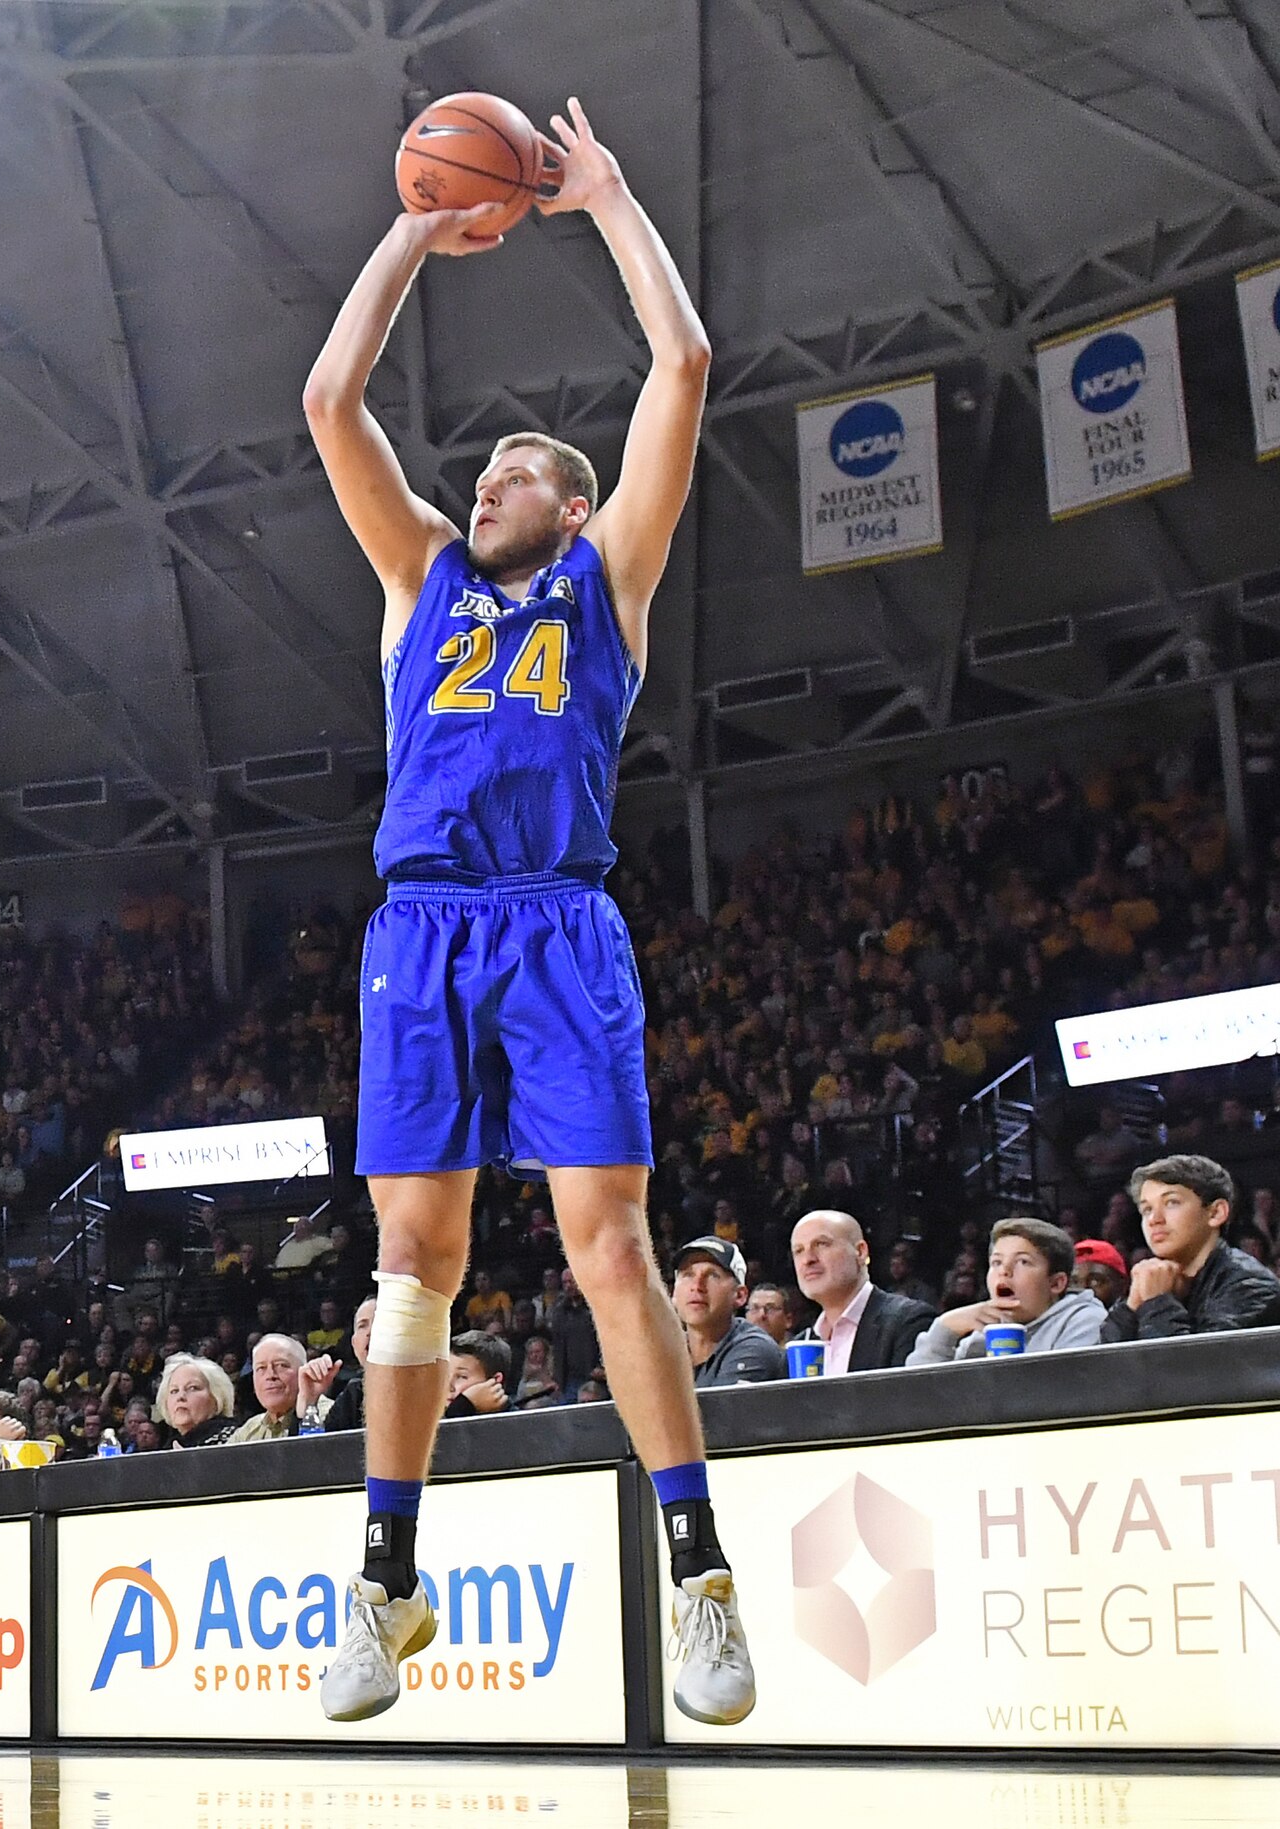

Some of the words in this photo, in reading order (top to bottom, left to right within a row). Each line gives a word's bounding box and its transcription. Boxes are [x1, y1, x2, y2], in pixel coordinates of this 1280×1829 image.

[1083, 411, 1149, 441] FINAL
[1088, 428, 1144, 459] FOUR
[1091, 451, 1145, 485] 1965
[819, 474, 921, 505] MIDWEST
[816, 490, 923, 524] REGIONAL
[845, 516, 897, 547] 1964
[428, 619, 571, 717] 24
[194, 1556, 574, 1677] Acamy
[986, 1705, 1129, 1732] WICHITA
